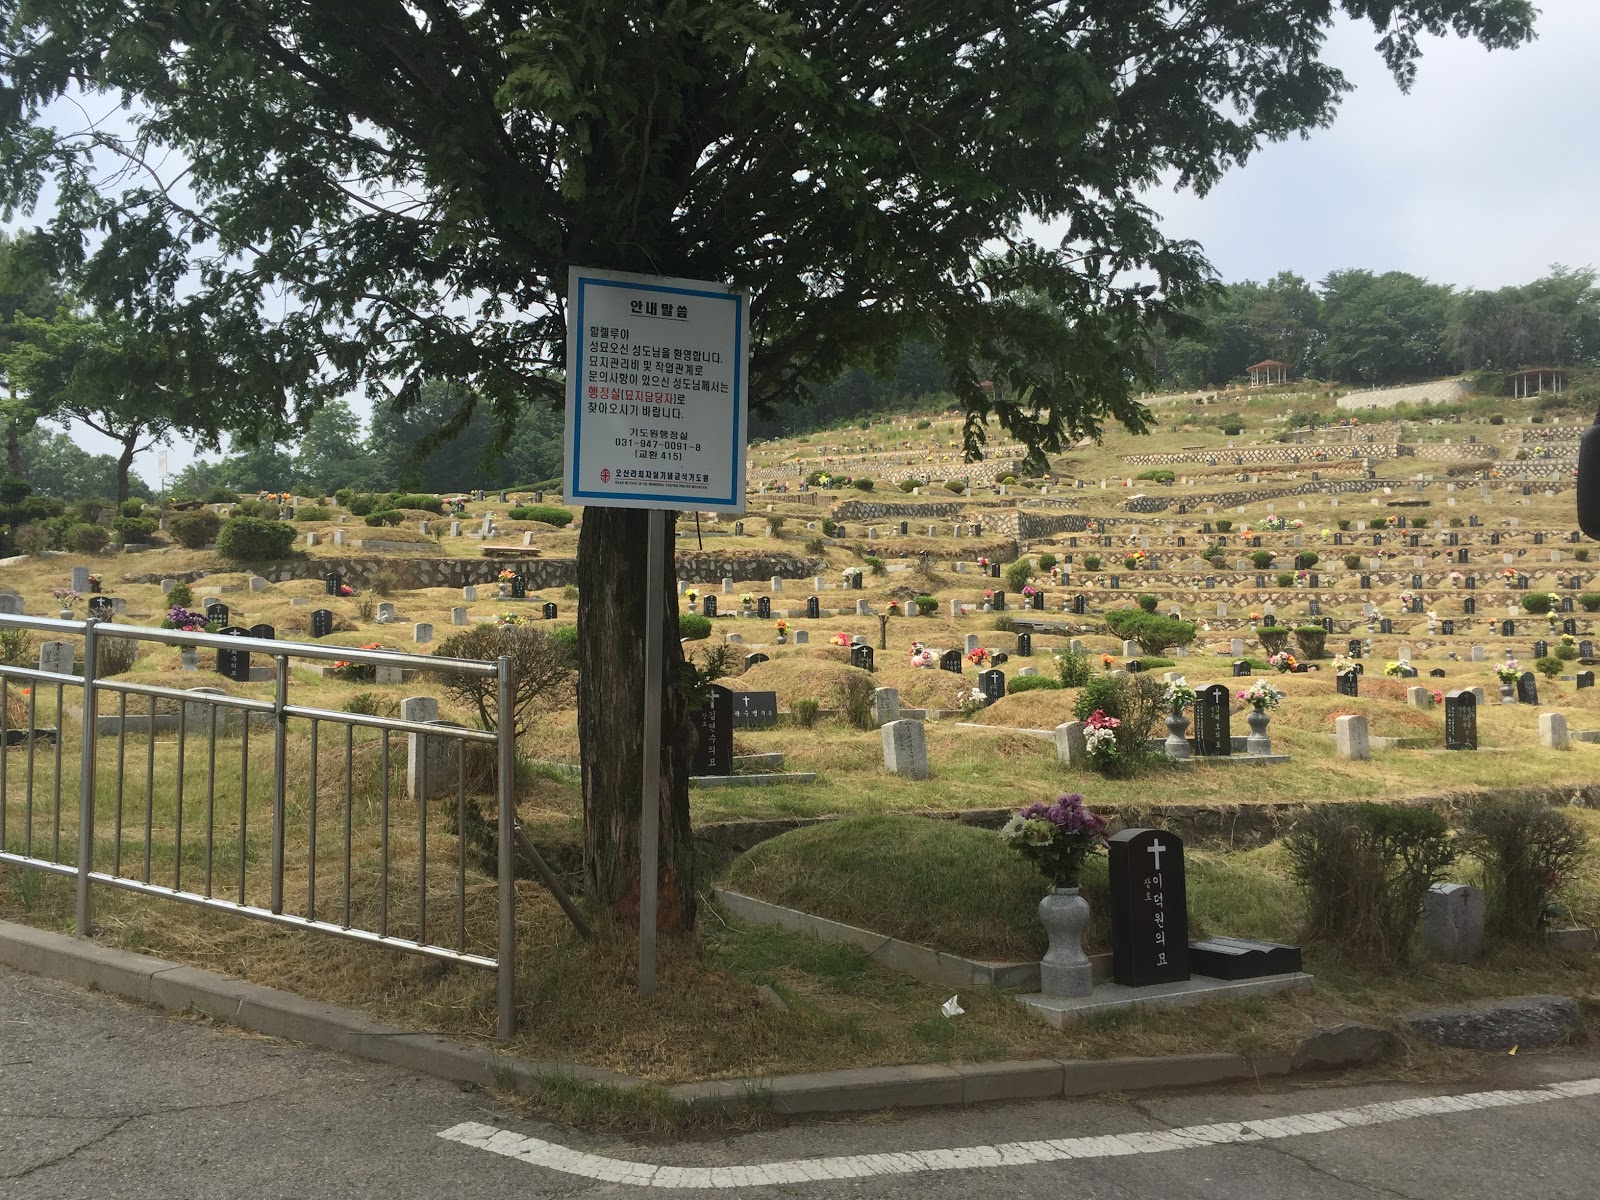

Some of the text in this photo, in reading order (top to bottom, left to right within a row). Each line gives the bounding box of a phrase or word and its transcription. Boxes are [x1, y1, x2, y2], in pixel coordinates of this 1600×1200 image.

[590, 325, 630, 341] 할렐루야
[589, 340, 723, 364] 성묘오신 성도님을 환영합니다.
[589, 355, 703, 377] 묘지관리비 및 작업관계로
[588, 370, 729, 394] 문의사항이 있으신 성도님께서는
[587, 401, 684, 420] 찾아오시기 바랍니다.
[629, 427, 688, 441] 기도원행정실
[615, 437, 701, 452] 031-947-0091~8
[634, 449, 682, 462] (교환 415)
